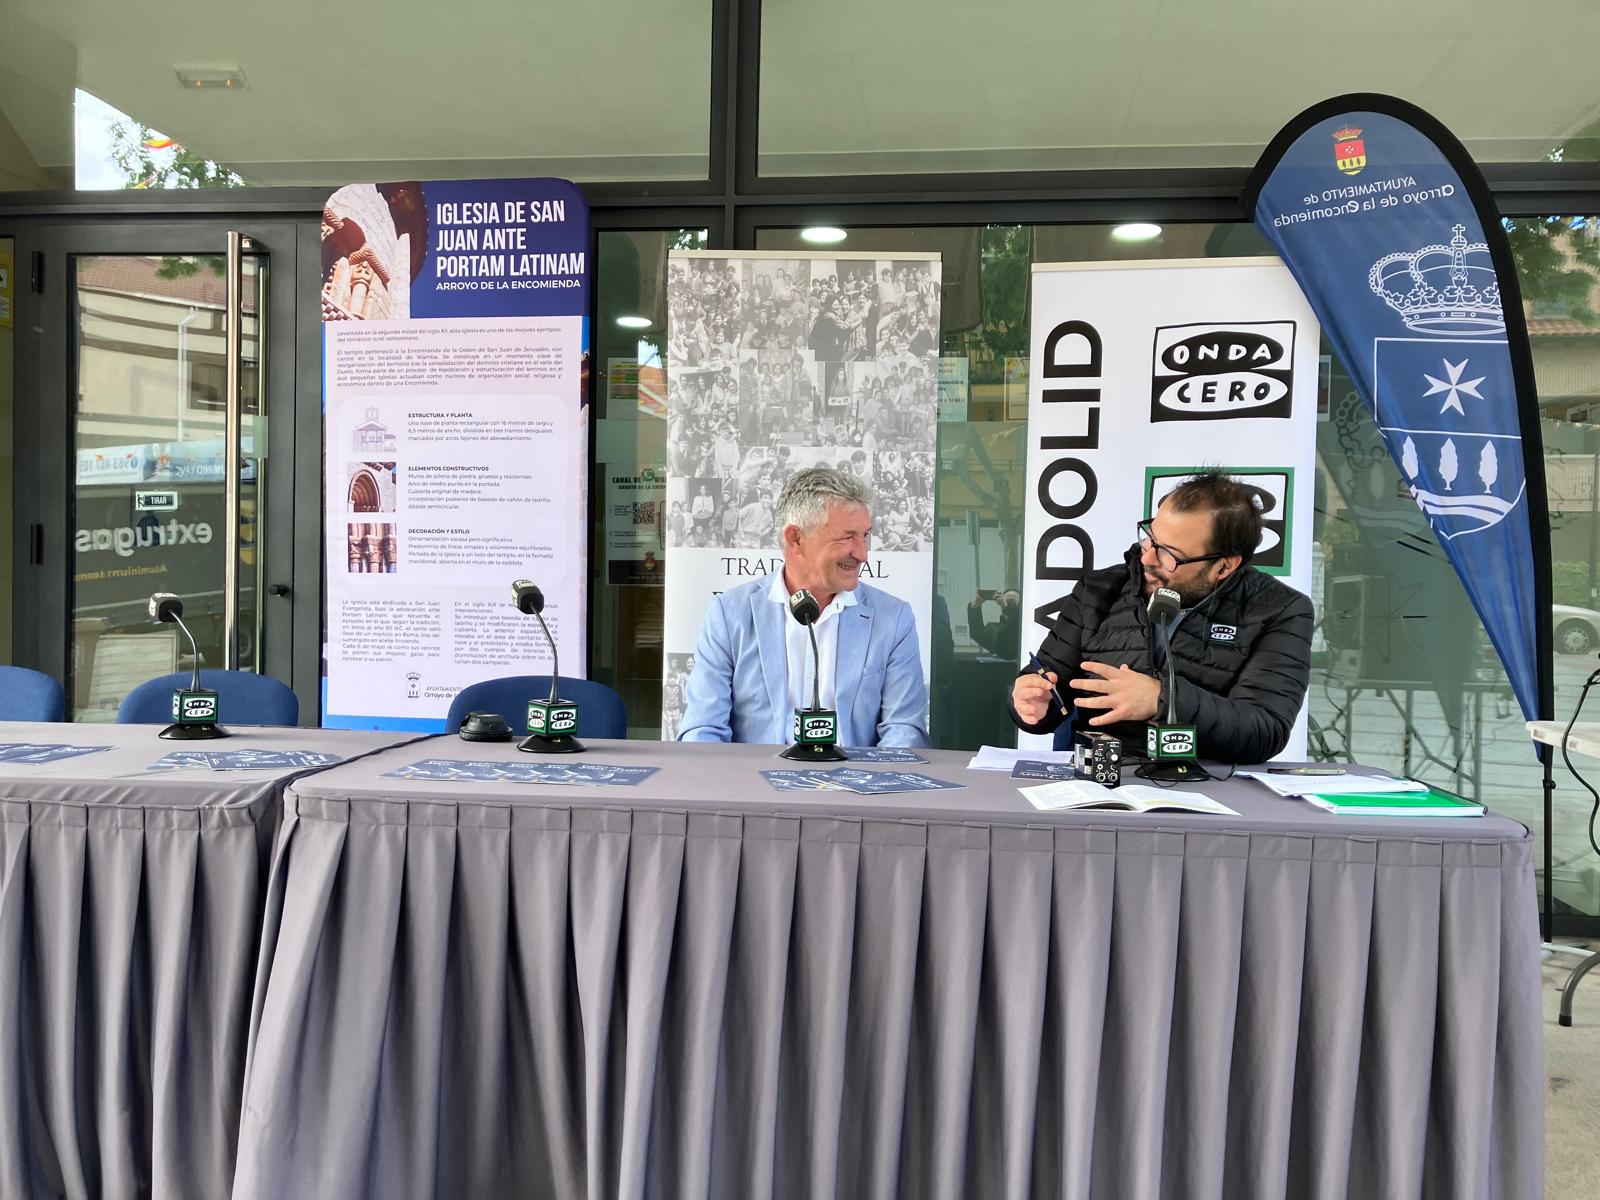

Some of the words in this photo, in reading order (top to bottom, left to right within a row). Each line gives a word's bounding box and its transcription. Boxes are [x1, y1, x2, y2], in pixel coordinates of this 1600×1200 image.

[436, 202, 500, 224] IGLESIA
[504, 202, 526, 223] DE
[530, 200, 565, 222] SAN
[436, 229, 478, 251] JUAN
[482, 228, 526, 250] ANTE
[436, 254, 504, 277] PORTAM
[510, 252, 584, 276] LATINAM
[436, 281, 478, 290] ARROYO
[481, 281, 494, 290] DE
[497, 281, 509, 289] LA
[512, 280, 580, 289] ENCOMIENDA
[1173, 343, 1271, 364] ONDA
[1177, 380, 1270, 404] CERO
[612, 476, 632, 484] CANAL
[150, 496, 167, 505] TIRAR
